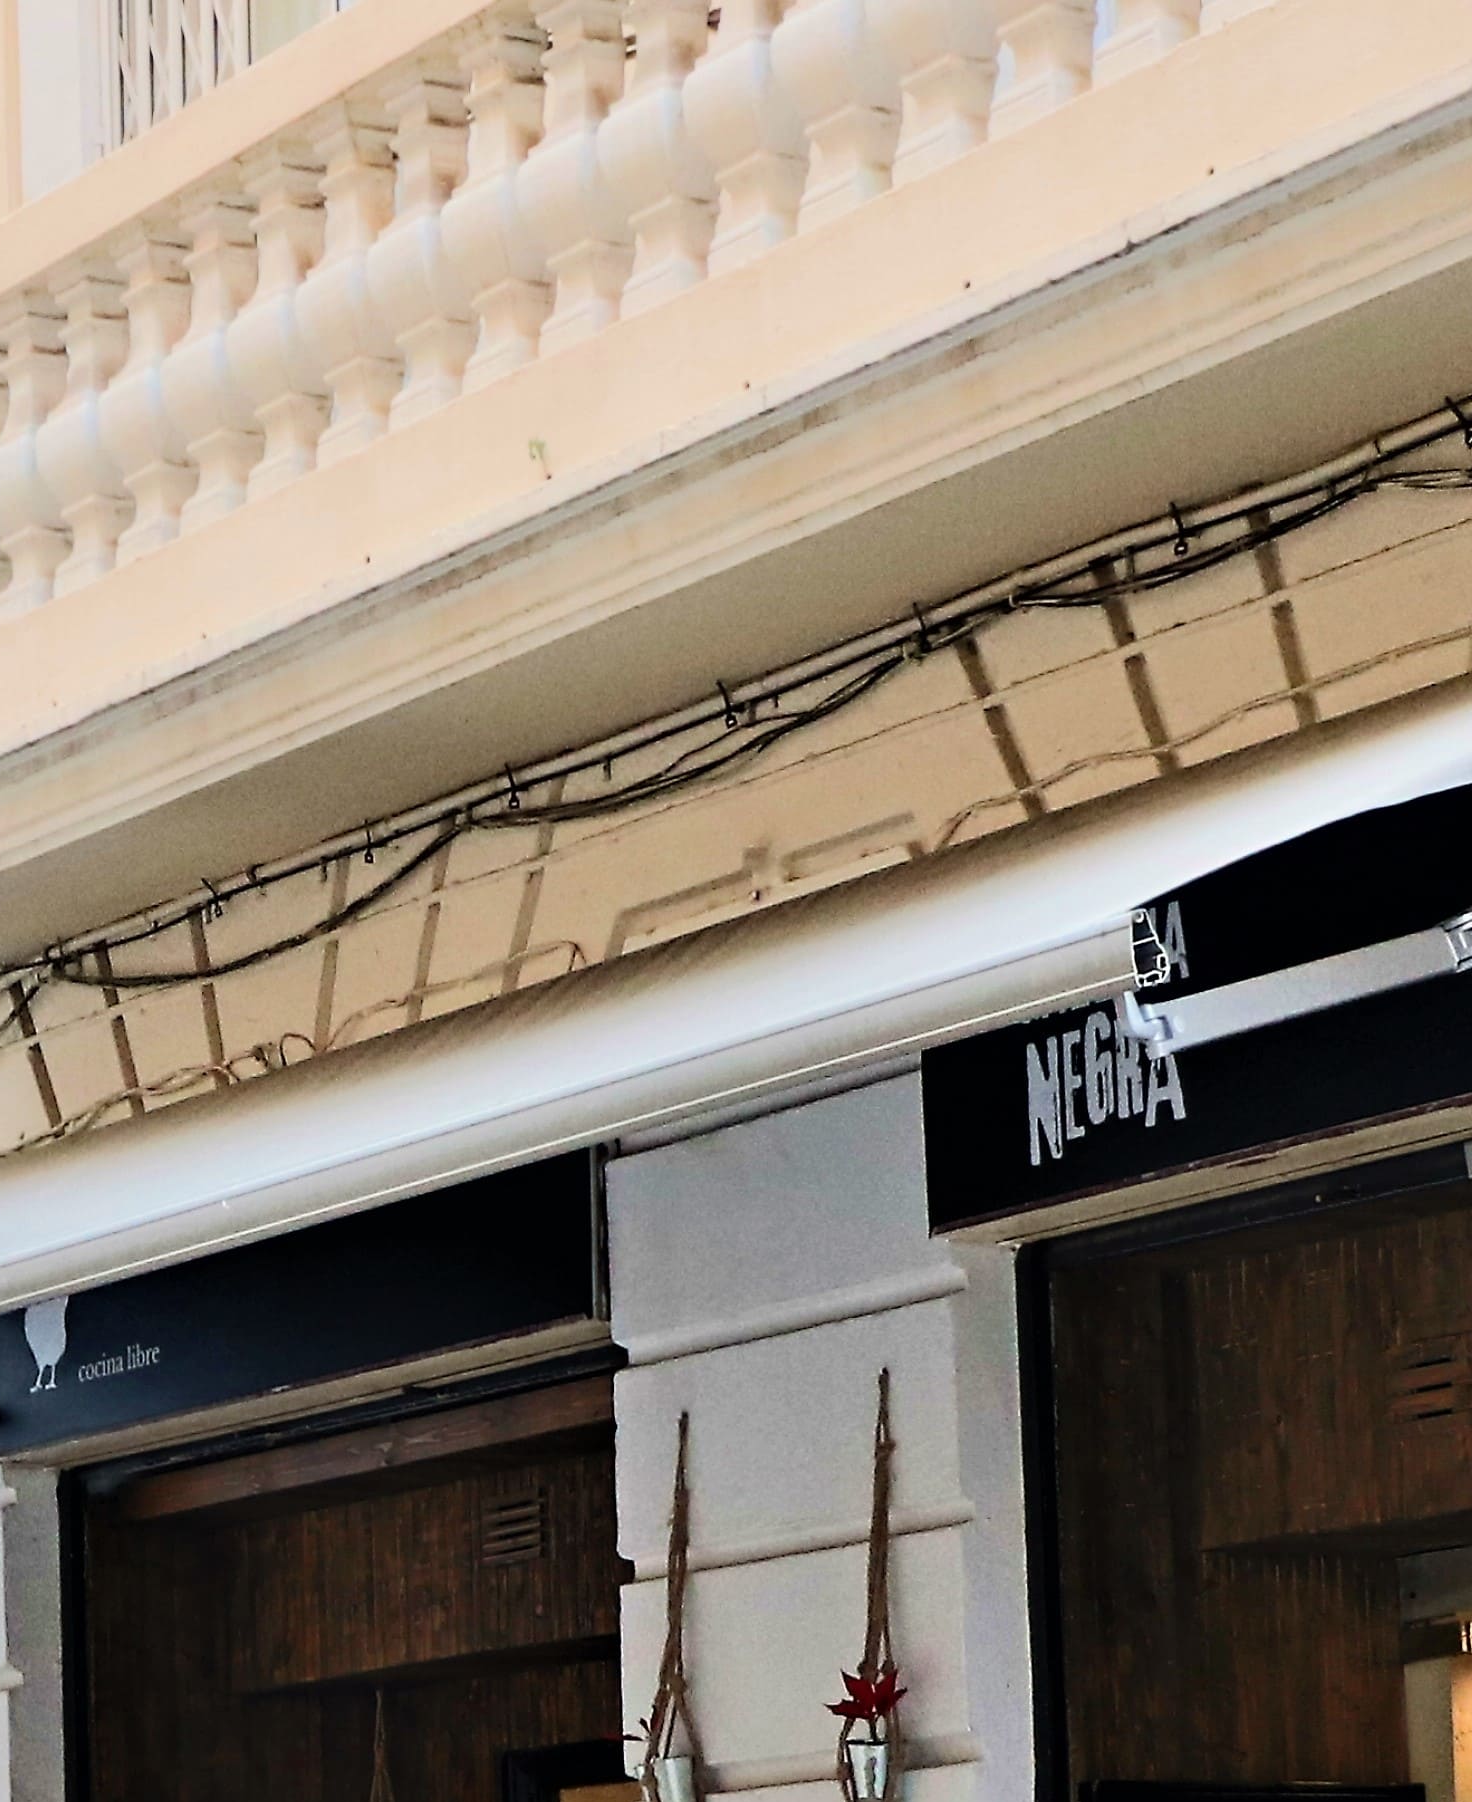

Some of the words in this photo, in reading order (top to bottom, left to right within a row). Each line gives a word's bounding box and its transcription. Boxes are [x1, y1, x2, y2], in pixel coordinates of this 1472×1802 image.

[1026, 1004, 1187, 1166] NEGRA
[78, 1352, 124, 1382] cocina
[127, 1343, 160, 1370] libre
